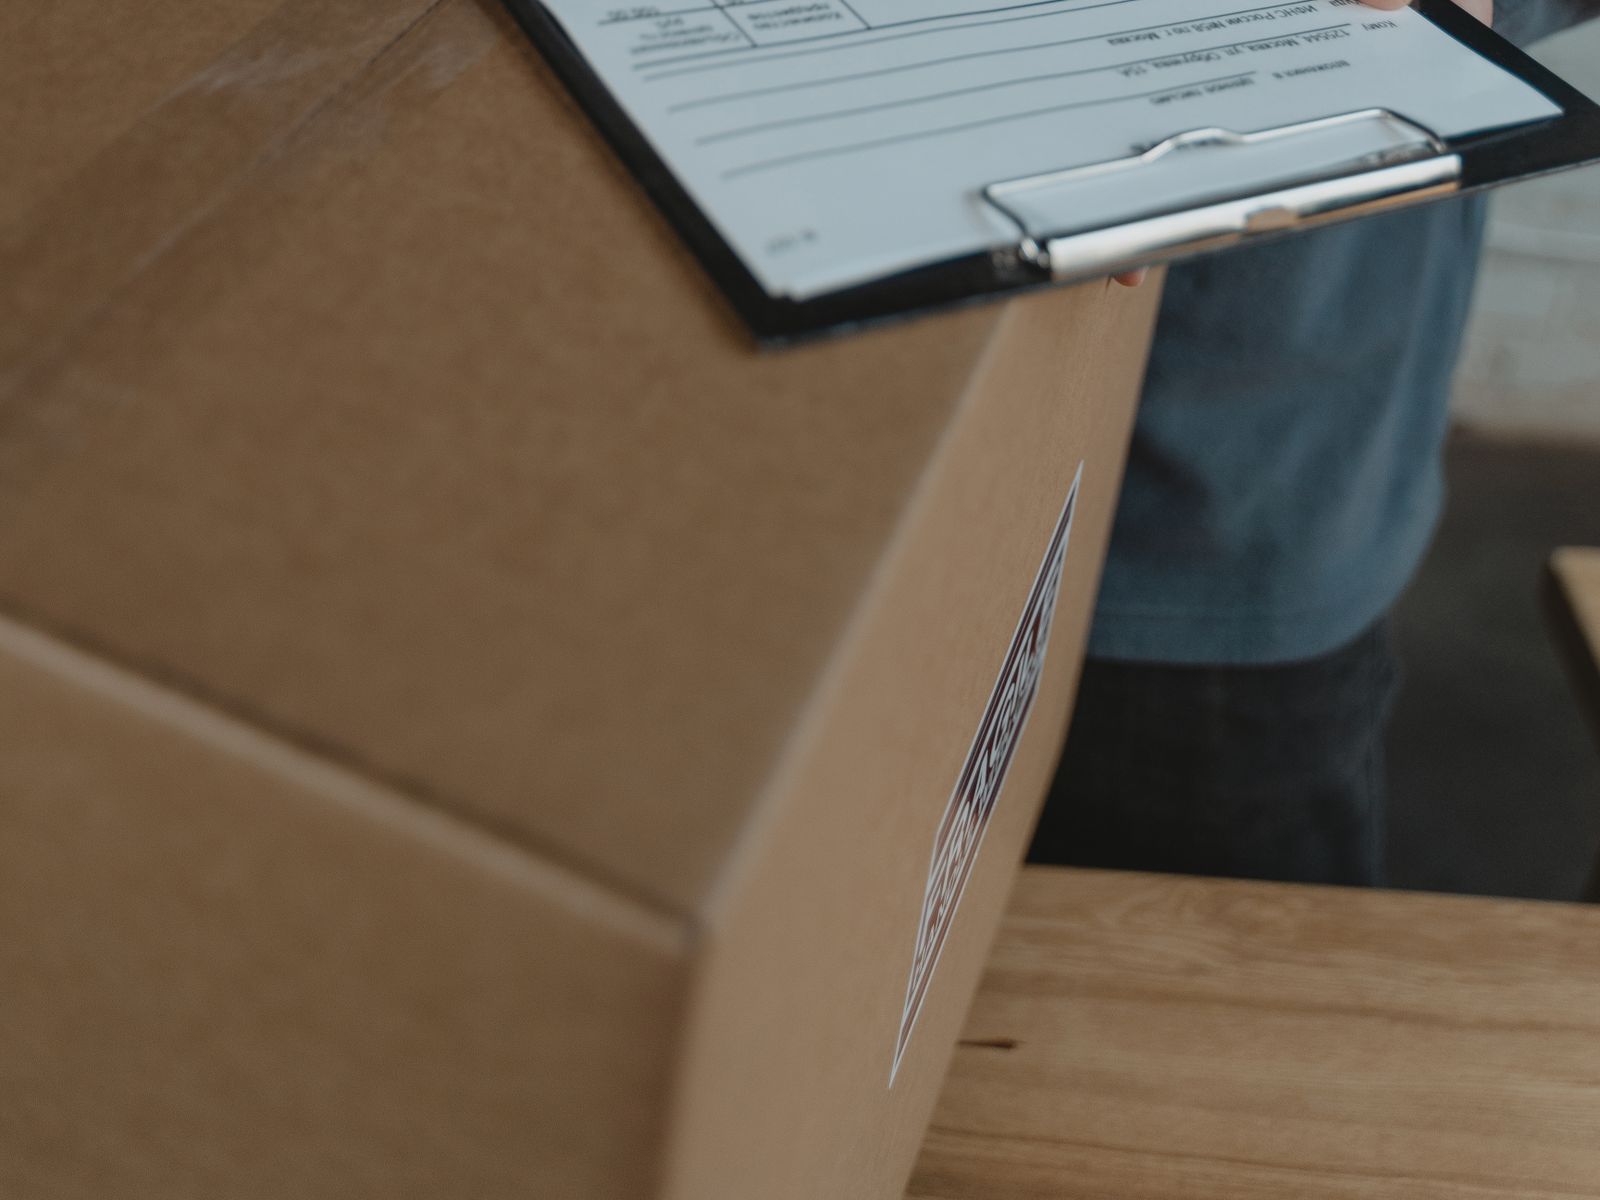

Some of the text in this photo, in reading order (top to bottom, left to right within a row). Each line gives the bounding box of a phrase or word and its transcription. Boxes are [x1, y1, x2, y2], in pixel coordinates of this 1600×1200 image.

[1271, 3, 1320, 18] ИФНС
[1222, 10, 1277, 27] России
[1357, 18, 1399, 33] Кому
